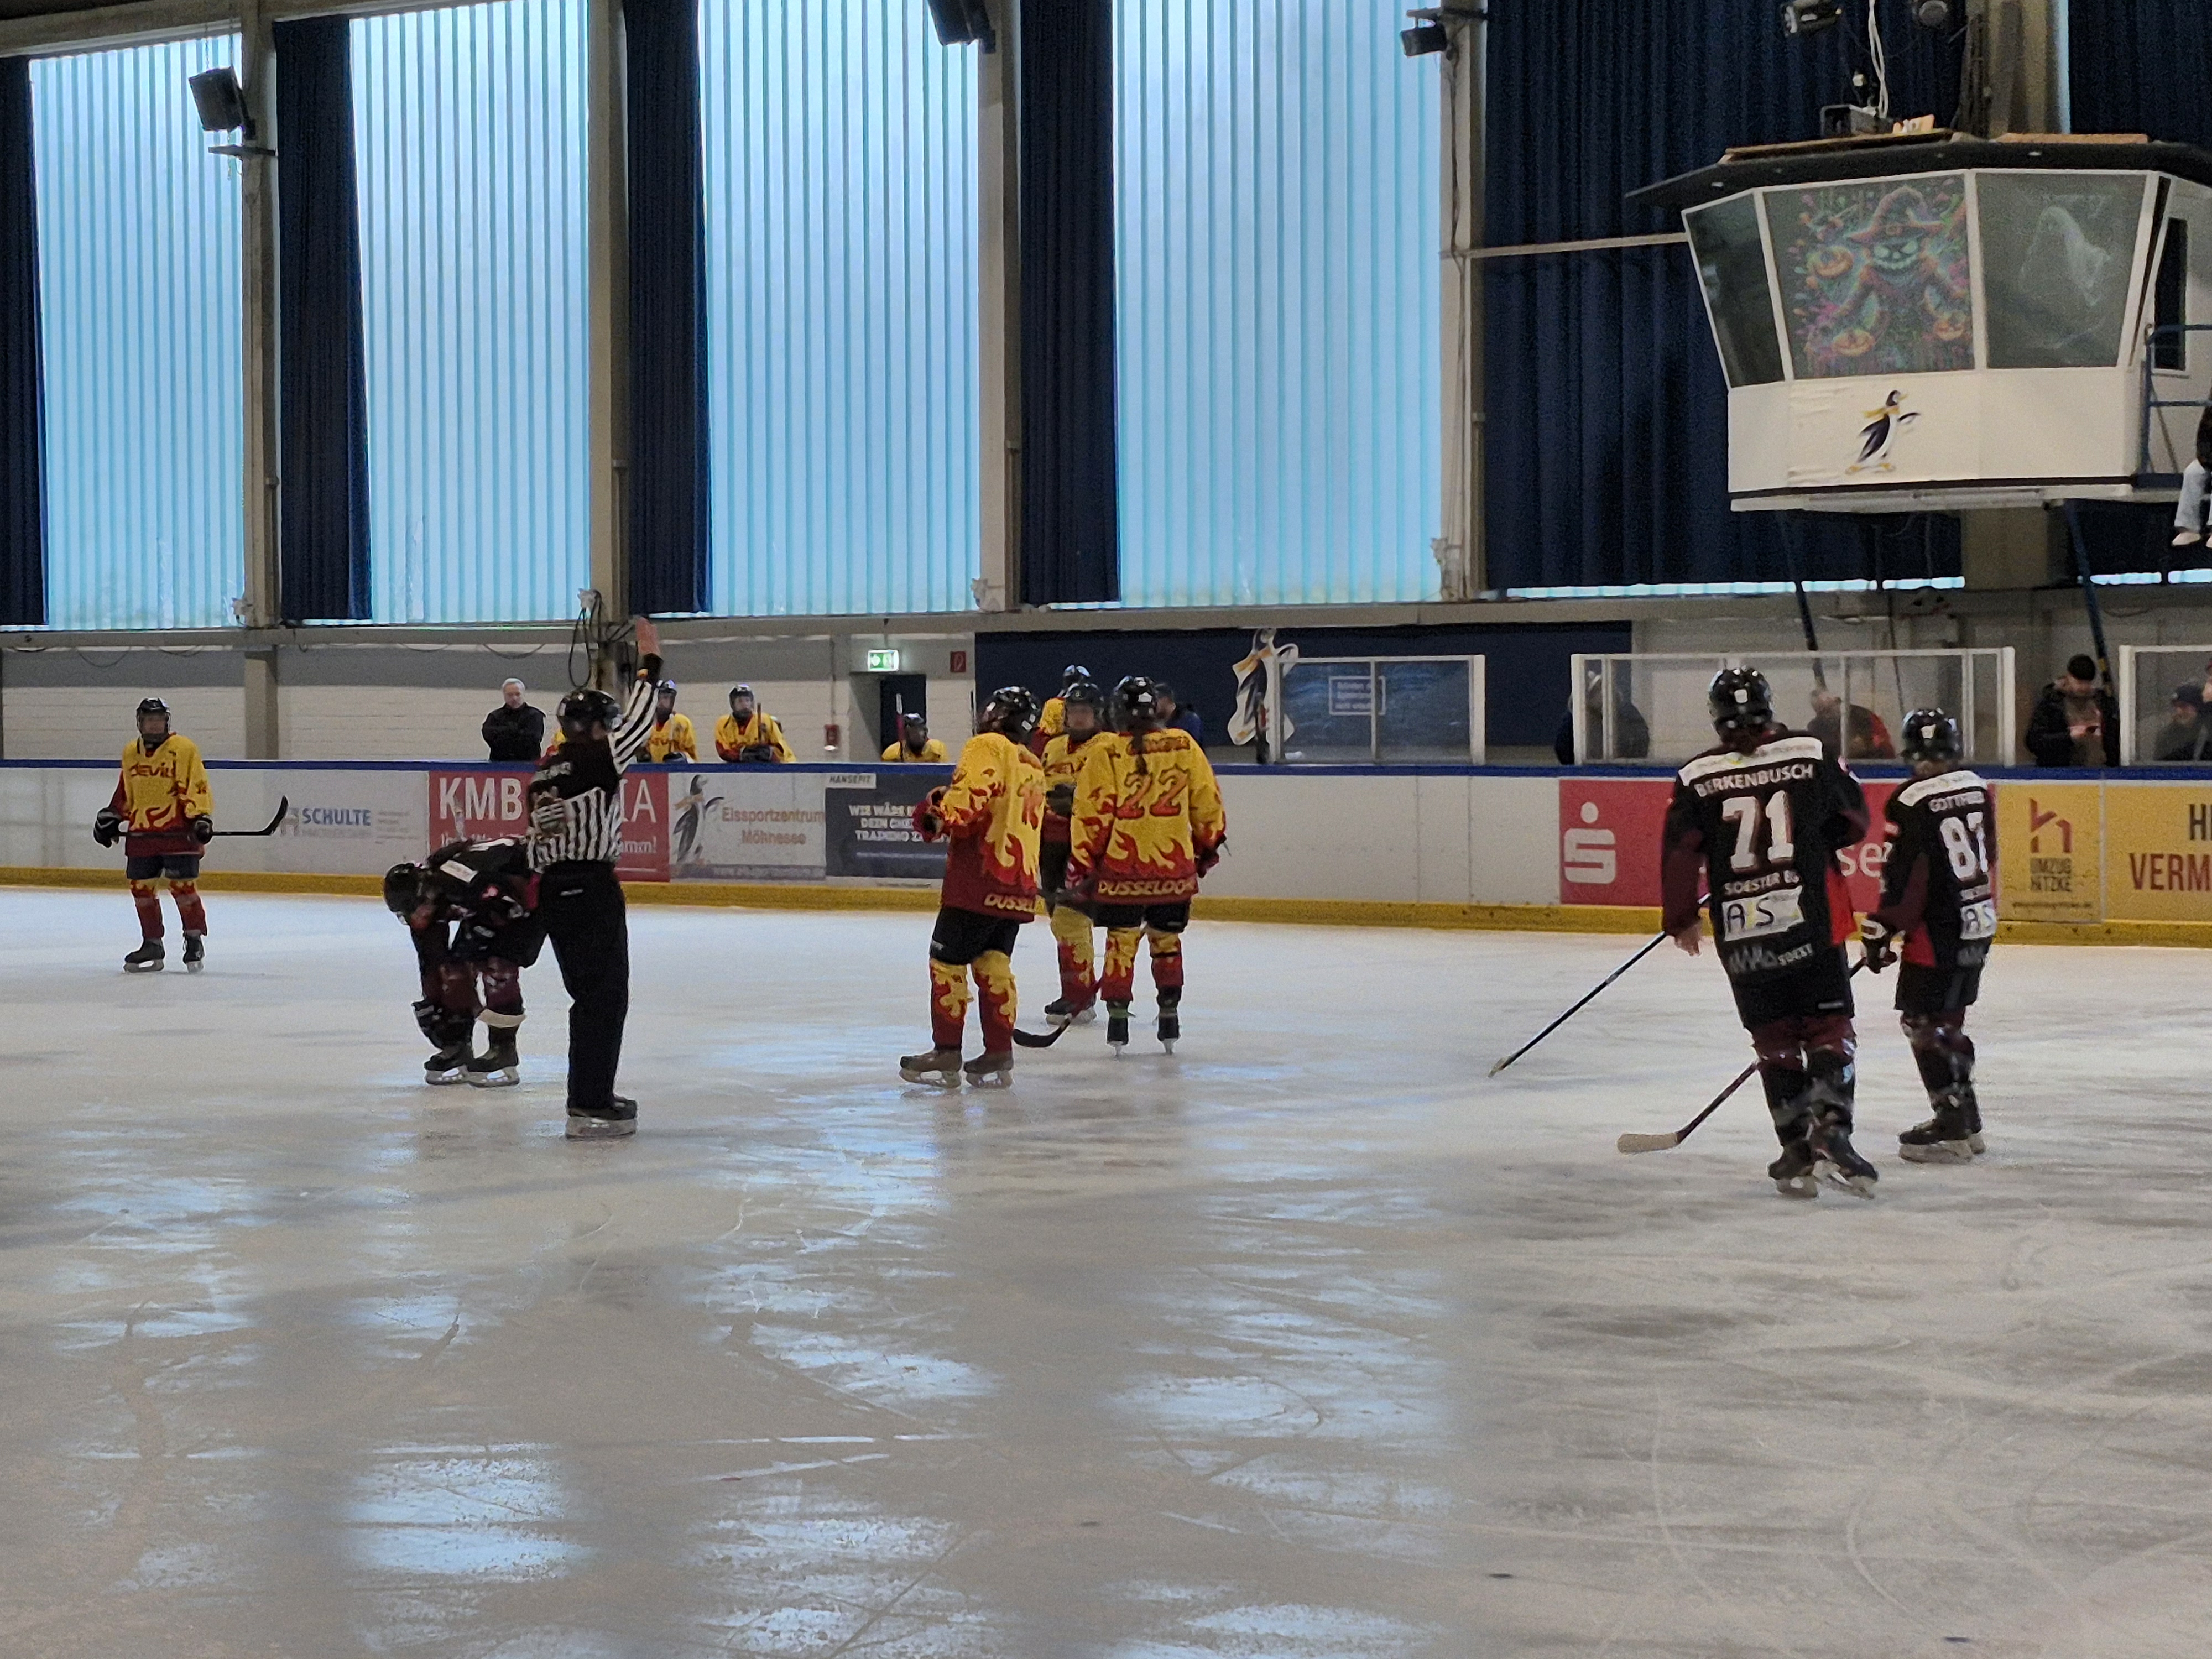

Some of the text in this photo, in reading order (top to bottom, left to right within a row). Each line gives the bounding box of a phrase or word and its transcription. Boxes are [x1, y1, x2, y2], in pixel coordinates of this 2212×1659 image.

[440, 777, 523, 821] KMB
[1113, 763, 1190, 820] 22
[302, 808, 371, 826] SCHULTE
[1721, 790, 1794, 870] 71
